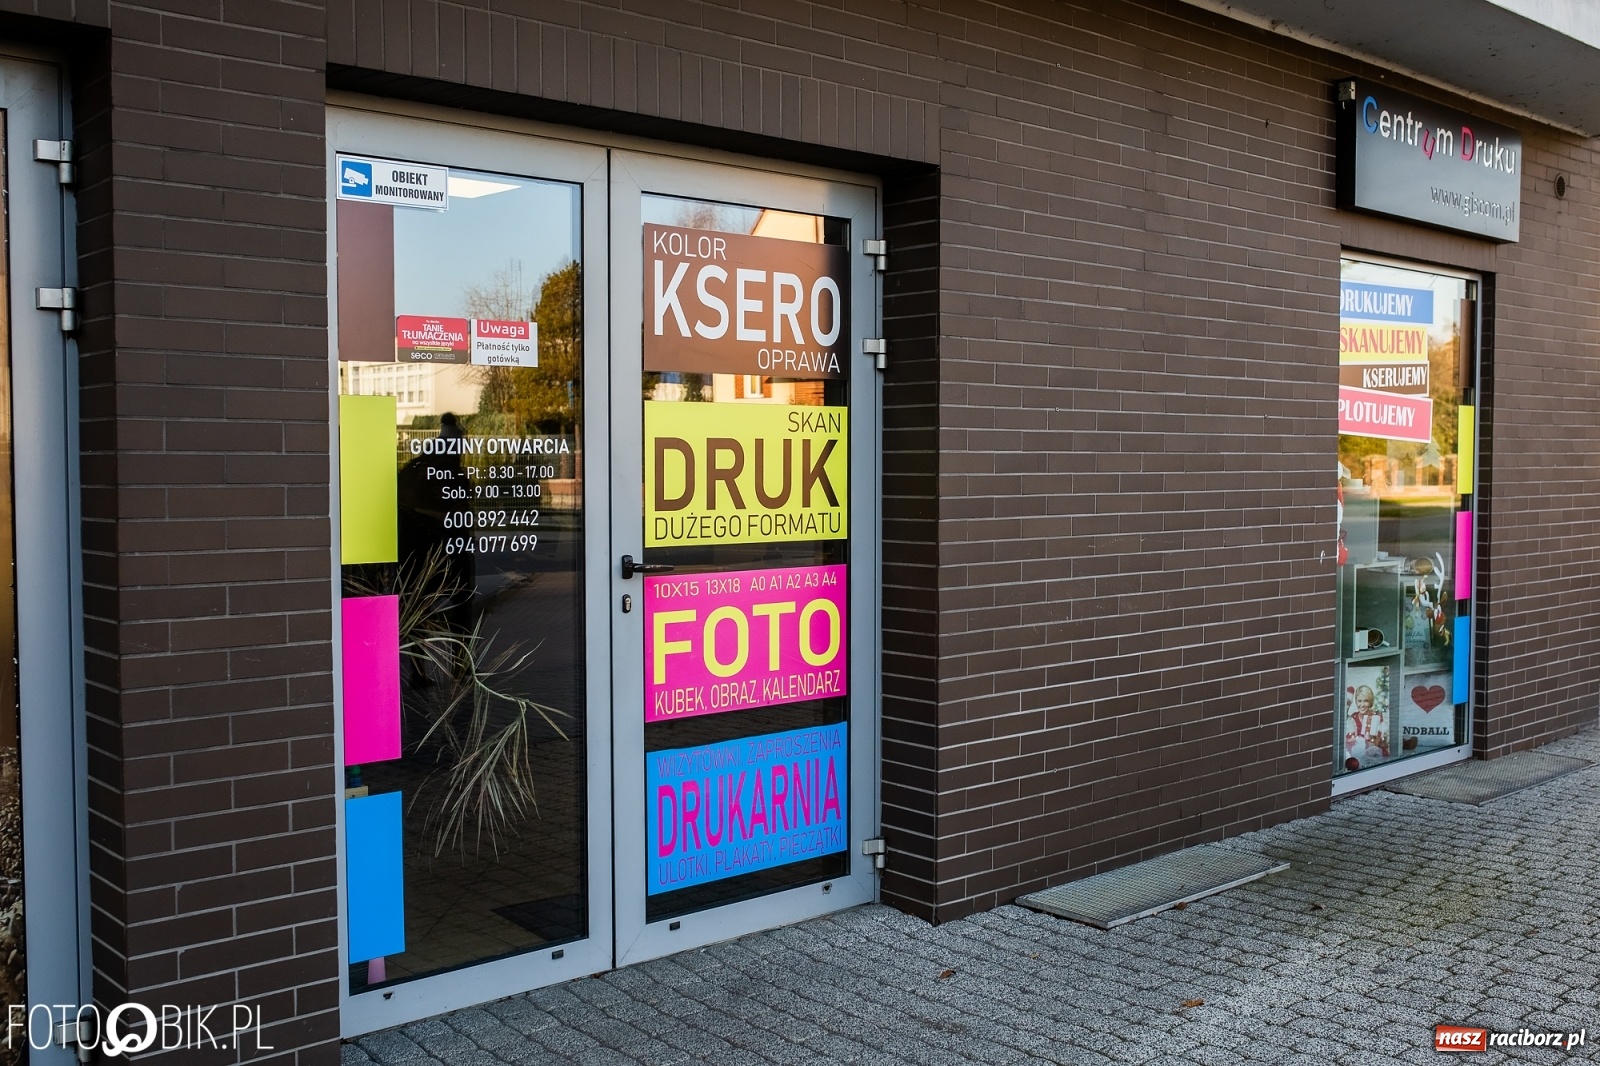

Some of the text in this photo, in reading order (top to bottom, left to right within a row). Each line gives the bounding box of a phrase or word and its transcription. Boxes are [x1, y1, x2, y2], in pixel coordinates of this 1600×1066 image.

[1461, 126, 1516, 174] Druku
[391, 170, 428, 186] OBIEKT
[375, 185, 444, 202] MONITOROWANY
[1430, 186, 1515, 226] www.giscom.pl
[653, 230, 727, 261] KOLOR
[654, 259, 841, 347] KSERO
[401, 330, 464, 342] TŁUMACZENIA
[422, 323, 444, 333] TANIE
[480, 321, 525, 337] Uwaga
[477, 341, 530, 353] Płatność tylko
[1340, 327, 1425, 355] SKANUJEMY
[411, 351, 433, 360] seco
[487, 354, 520, 365] gotówką
[757, 348, 841, 374] OPRAWA
[1363, 366, 1427, 388] KSERUJEMY
[787, 411, 841, 433] SKAN
[410, 438, 570, 455] GODZINY OTWARCIA
[426, 466, 455, 480] Pon.
[466, 466, 487, 480] Pt.:
[488, 465, 514, 479] 8.30
[525, 465, 554, 479] 17.00
[654, 437, 840, 512] DRUK
[441, 486, 473, 500] Sob.:
[511, 484, 541, 498] 13.00
[443, 509, 539, 529] 600 892 442
[654, 512, 841, 541] DUŻEGO FORMATU
[445, 534, 538, 555] 694 077 699
[653, 571, 837, 599] 10X15 13X18 A0 A1 A2 A3 A4
[653, 598, 841, 685] FOTO
[654, 669, 841, 716] KUBEK, OBRAZ, KALENDARZ
[656, 728, 842, 779] WIZYTÓWKI, ZAPROSZENIA
[657, 755, 842, 858] DRUKARNIA
[658, 824, 842, 886] ULOTKI, PLAKATY, PIECZĄTKI
